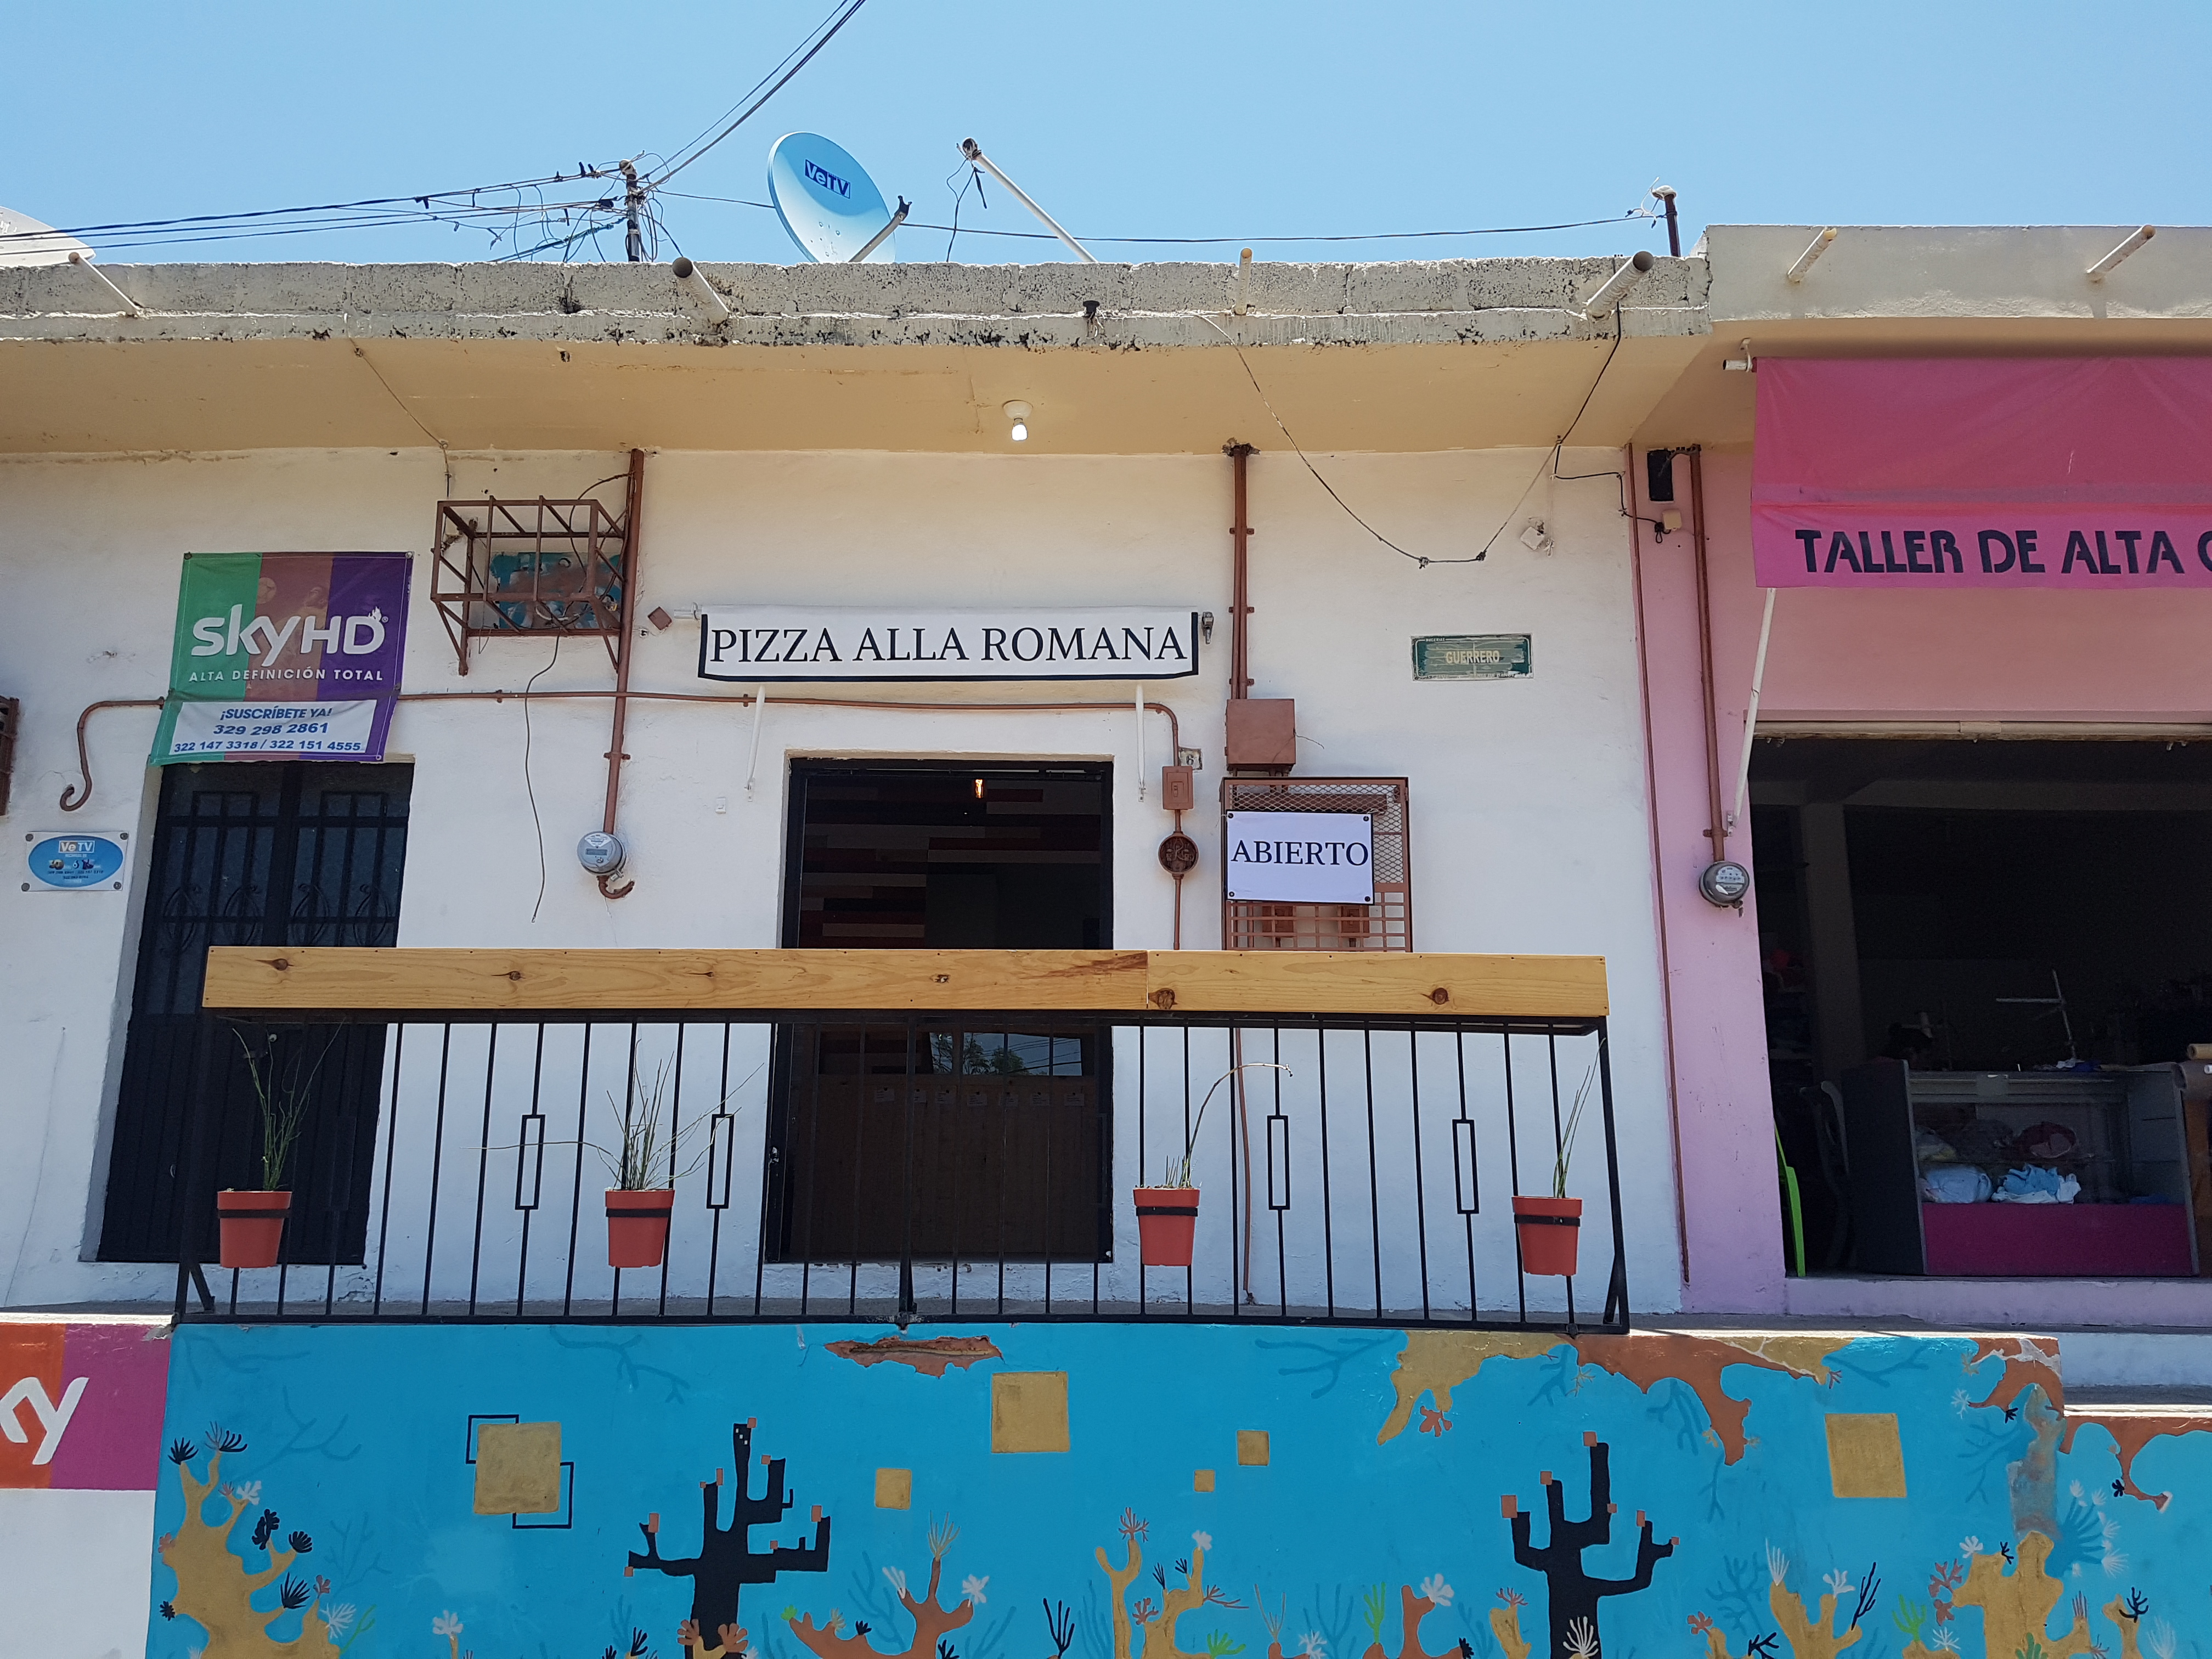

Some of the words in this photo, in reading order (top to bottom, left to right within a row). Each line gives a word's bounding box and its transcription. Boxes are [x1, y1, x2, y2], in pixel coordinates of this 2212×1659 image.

[806, 161, 849, 196] VeTV
[1795, 529, 1963, 573] TALLER
[1977, 529, 2045, 573] DE
[2061, 530, 2185, 574] ALTA
[710, 628, 843, 662] PIZZA
[852, 627, 970, 661] ALLA
[981, 626, 1188, 662] ROMANA
[1446, 650, 1500, 664] GUERRERO
[189, 671, 224, 682] ALTA
[232, 666, 325, 680] DEFINICIÓN
[334, 669, 383, 681] TOTAL
[220, 706, 307, 721] ¡SUSCRÍBETE
[310, 708, 333, 719] YA!
[213, 725, 246, 735] 329
[250, 725, 282, 736] 298
[286, 722, 328, 733] 2861
[174, 742, 195, 752] 322
[200, 741, 223, 750] 147
[225, 741, 258, 749] 3318
[269, 740, 294, 749] 322
[299, 740, 322, 750] 151
[327, 741, 361, 751] 4555
[61, 842, 93, 852] VeTV
[1231, 840, 1369, 866] ABIERTO
